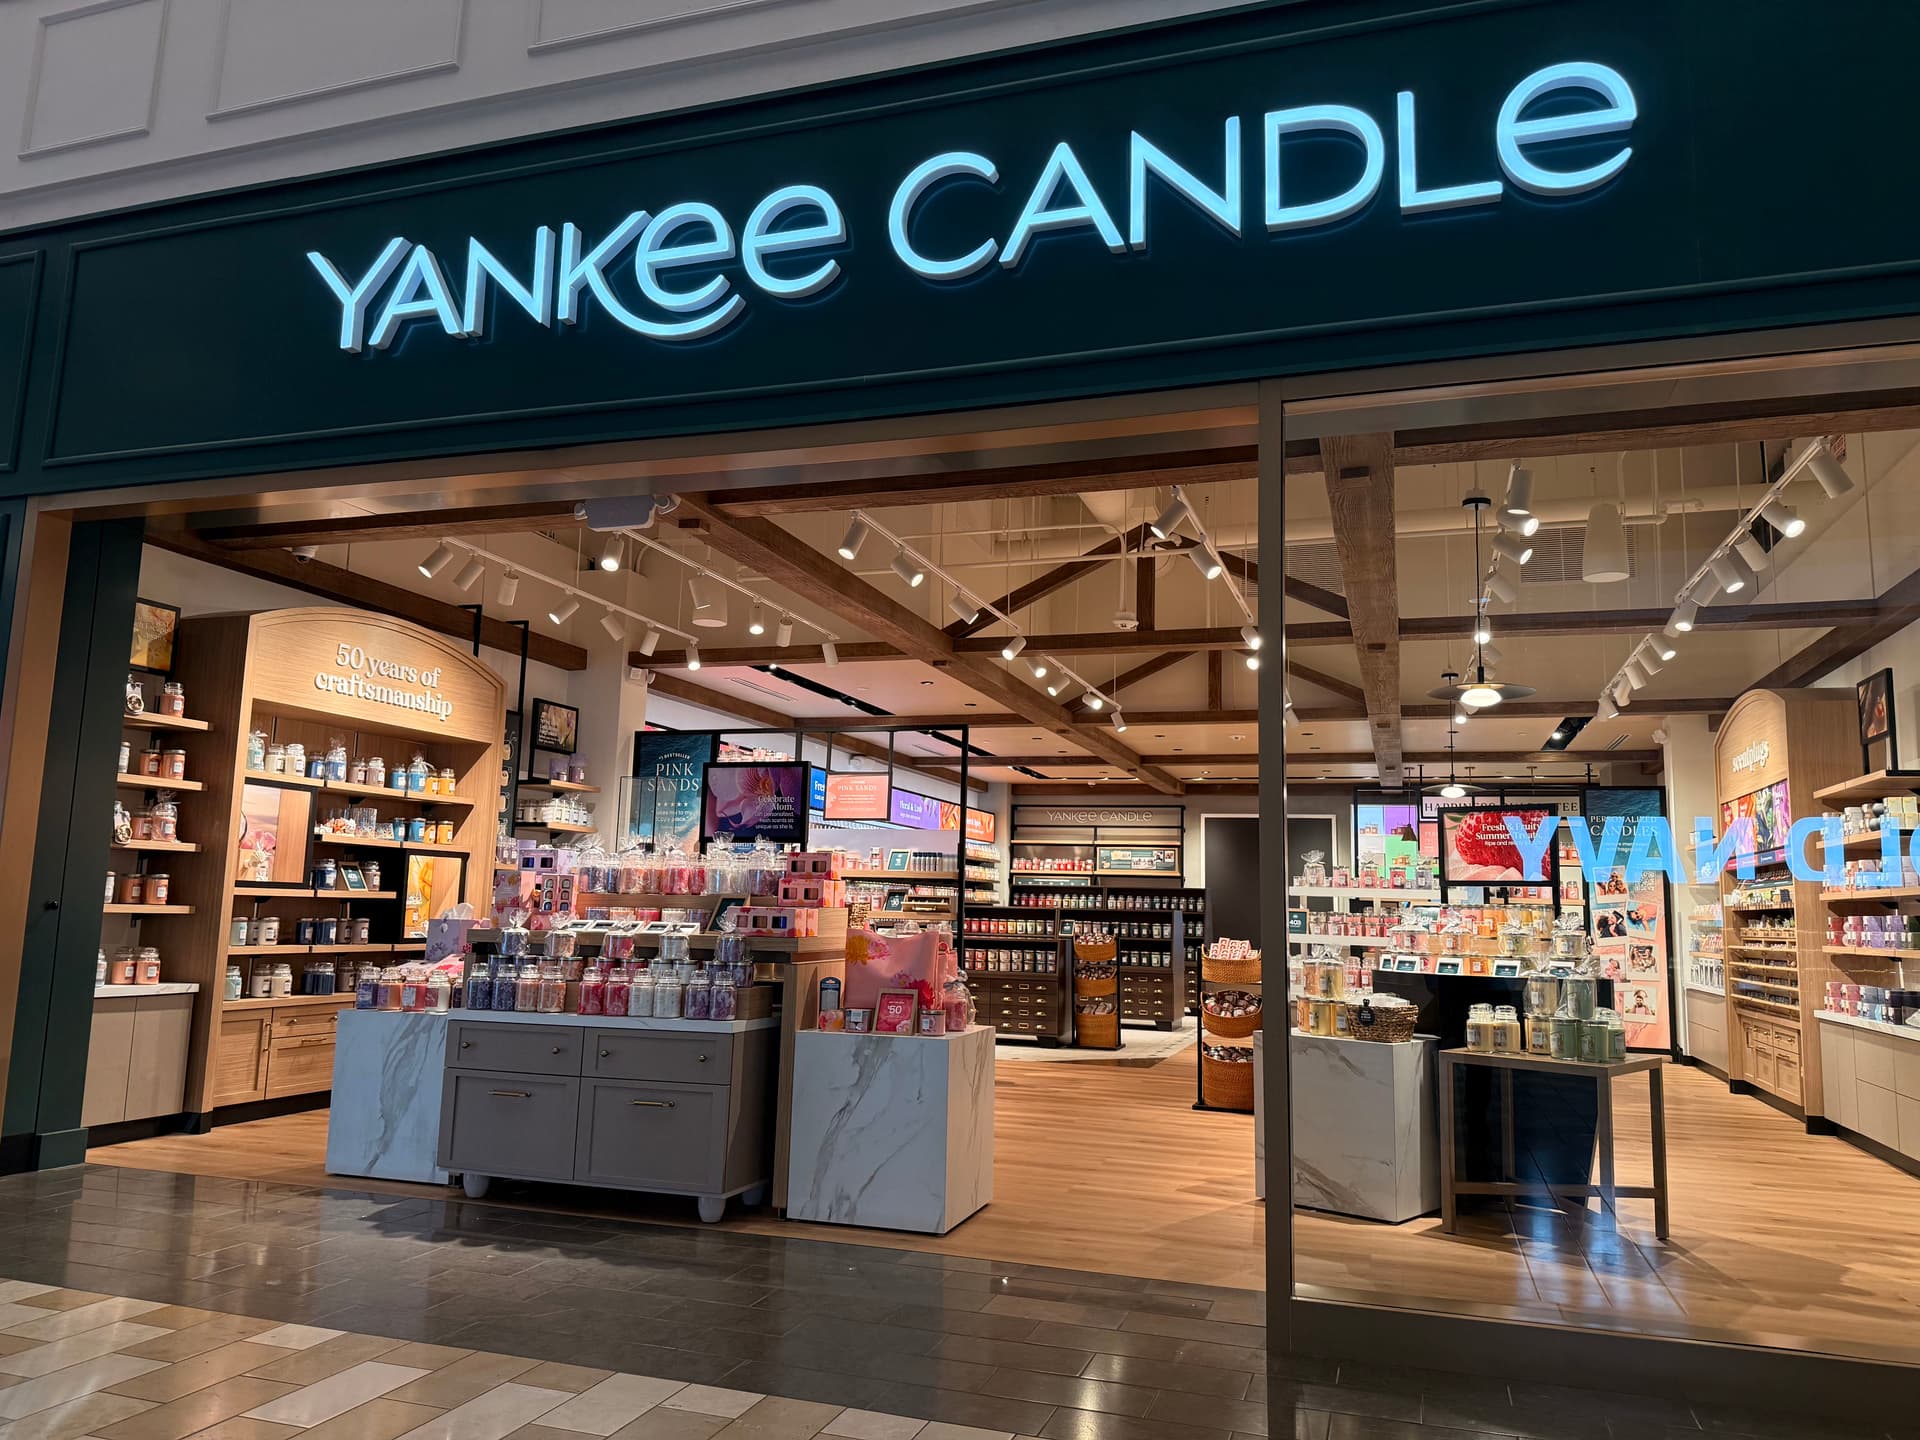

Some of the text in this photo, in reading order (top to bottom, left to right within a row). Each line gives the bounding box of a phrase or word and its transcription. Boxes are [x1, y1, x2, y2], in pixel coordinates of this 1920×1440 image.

[336, 642, 441, 688] 50 years of
[314, 671, 453, 722] craftsmanship
[656, 762, 693, 776] PINK
[647, 778, 699, 792] SANDS
[758, 794, 795, 802] Celebrate
[771, 803, 795, 811] Mom.
[1482, 822, 1541, 832] Fresh & Fruity
[1590, 825, 1657, 836] CANDLES
[1475, 832, 1510, 841] Summer
